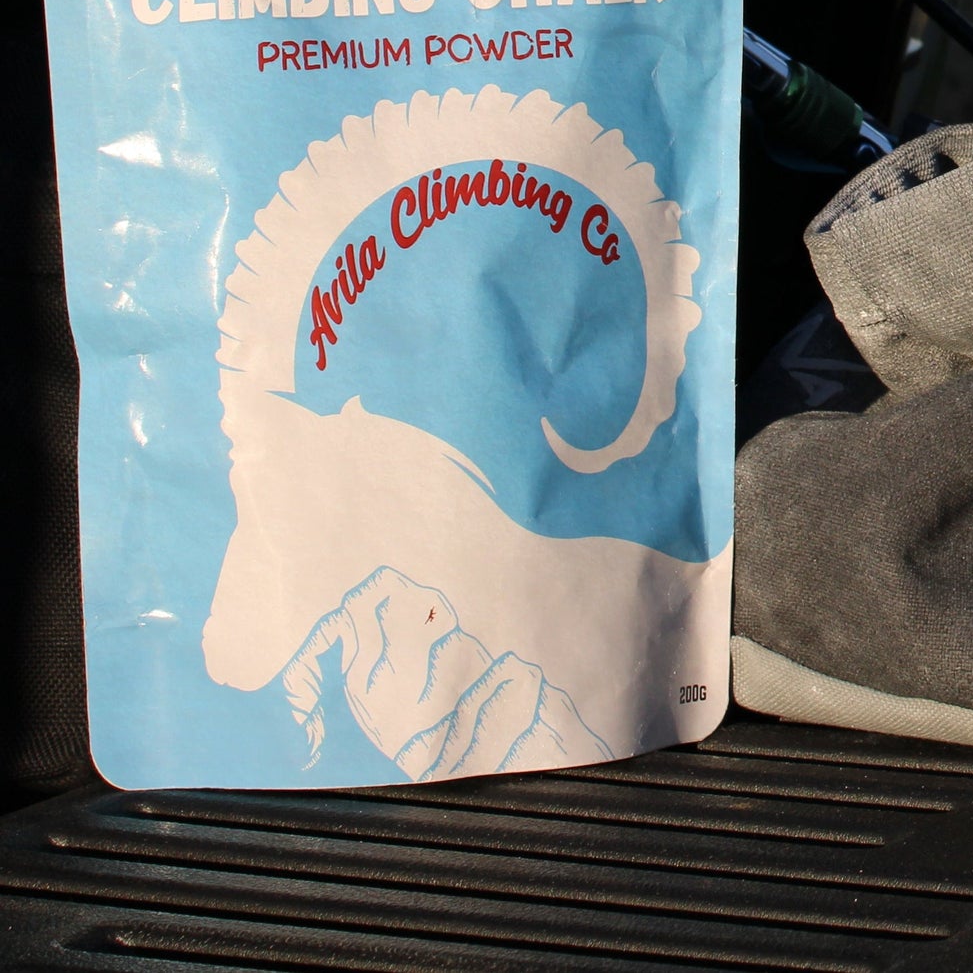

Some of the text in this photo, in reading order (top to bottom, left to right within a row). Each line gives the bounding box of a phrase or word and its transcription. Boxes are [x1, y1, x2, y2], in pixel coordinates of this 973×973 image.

[258, 28, 573, 72] PREMIUM POWDER
[310, 158, 621, 371] Avila Climbing Co
[679, 684, 707, 705] 200G
